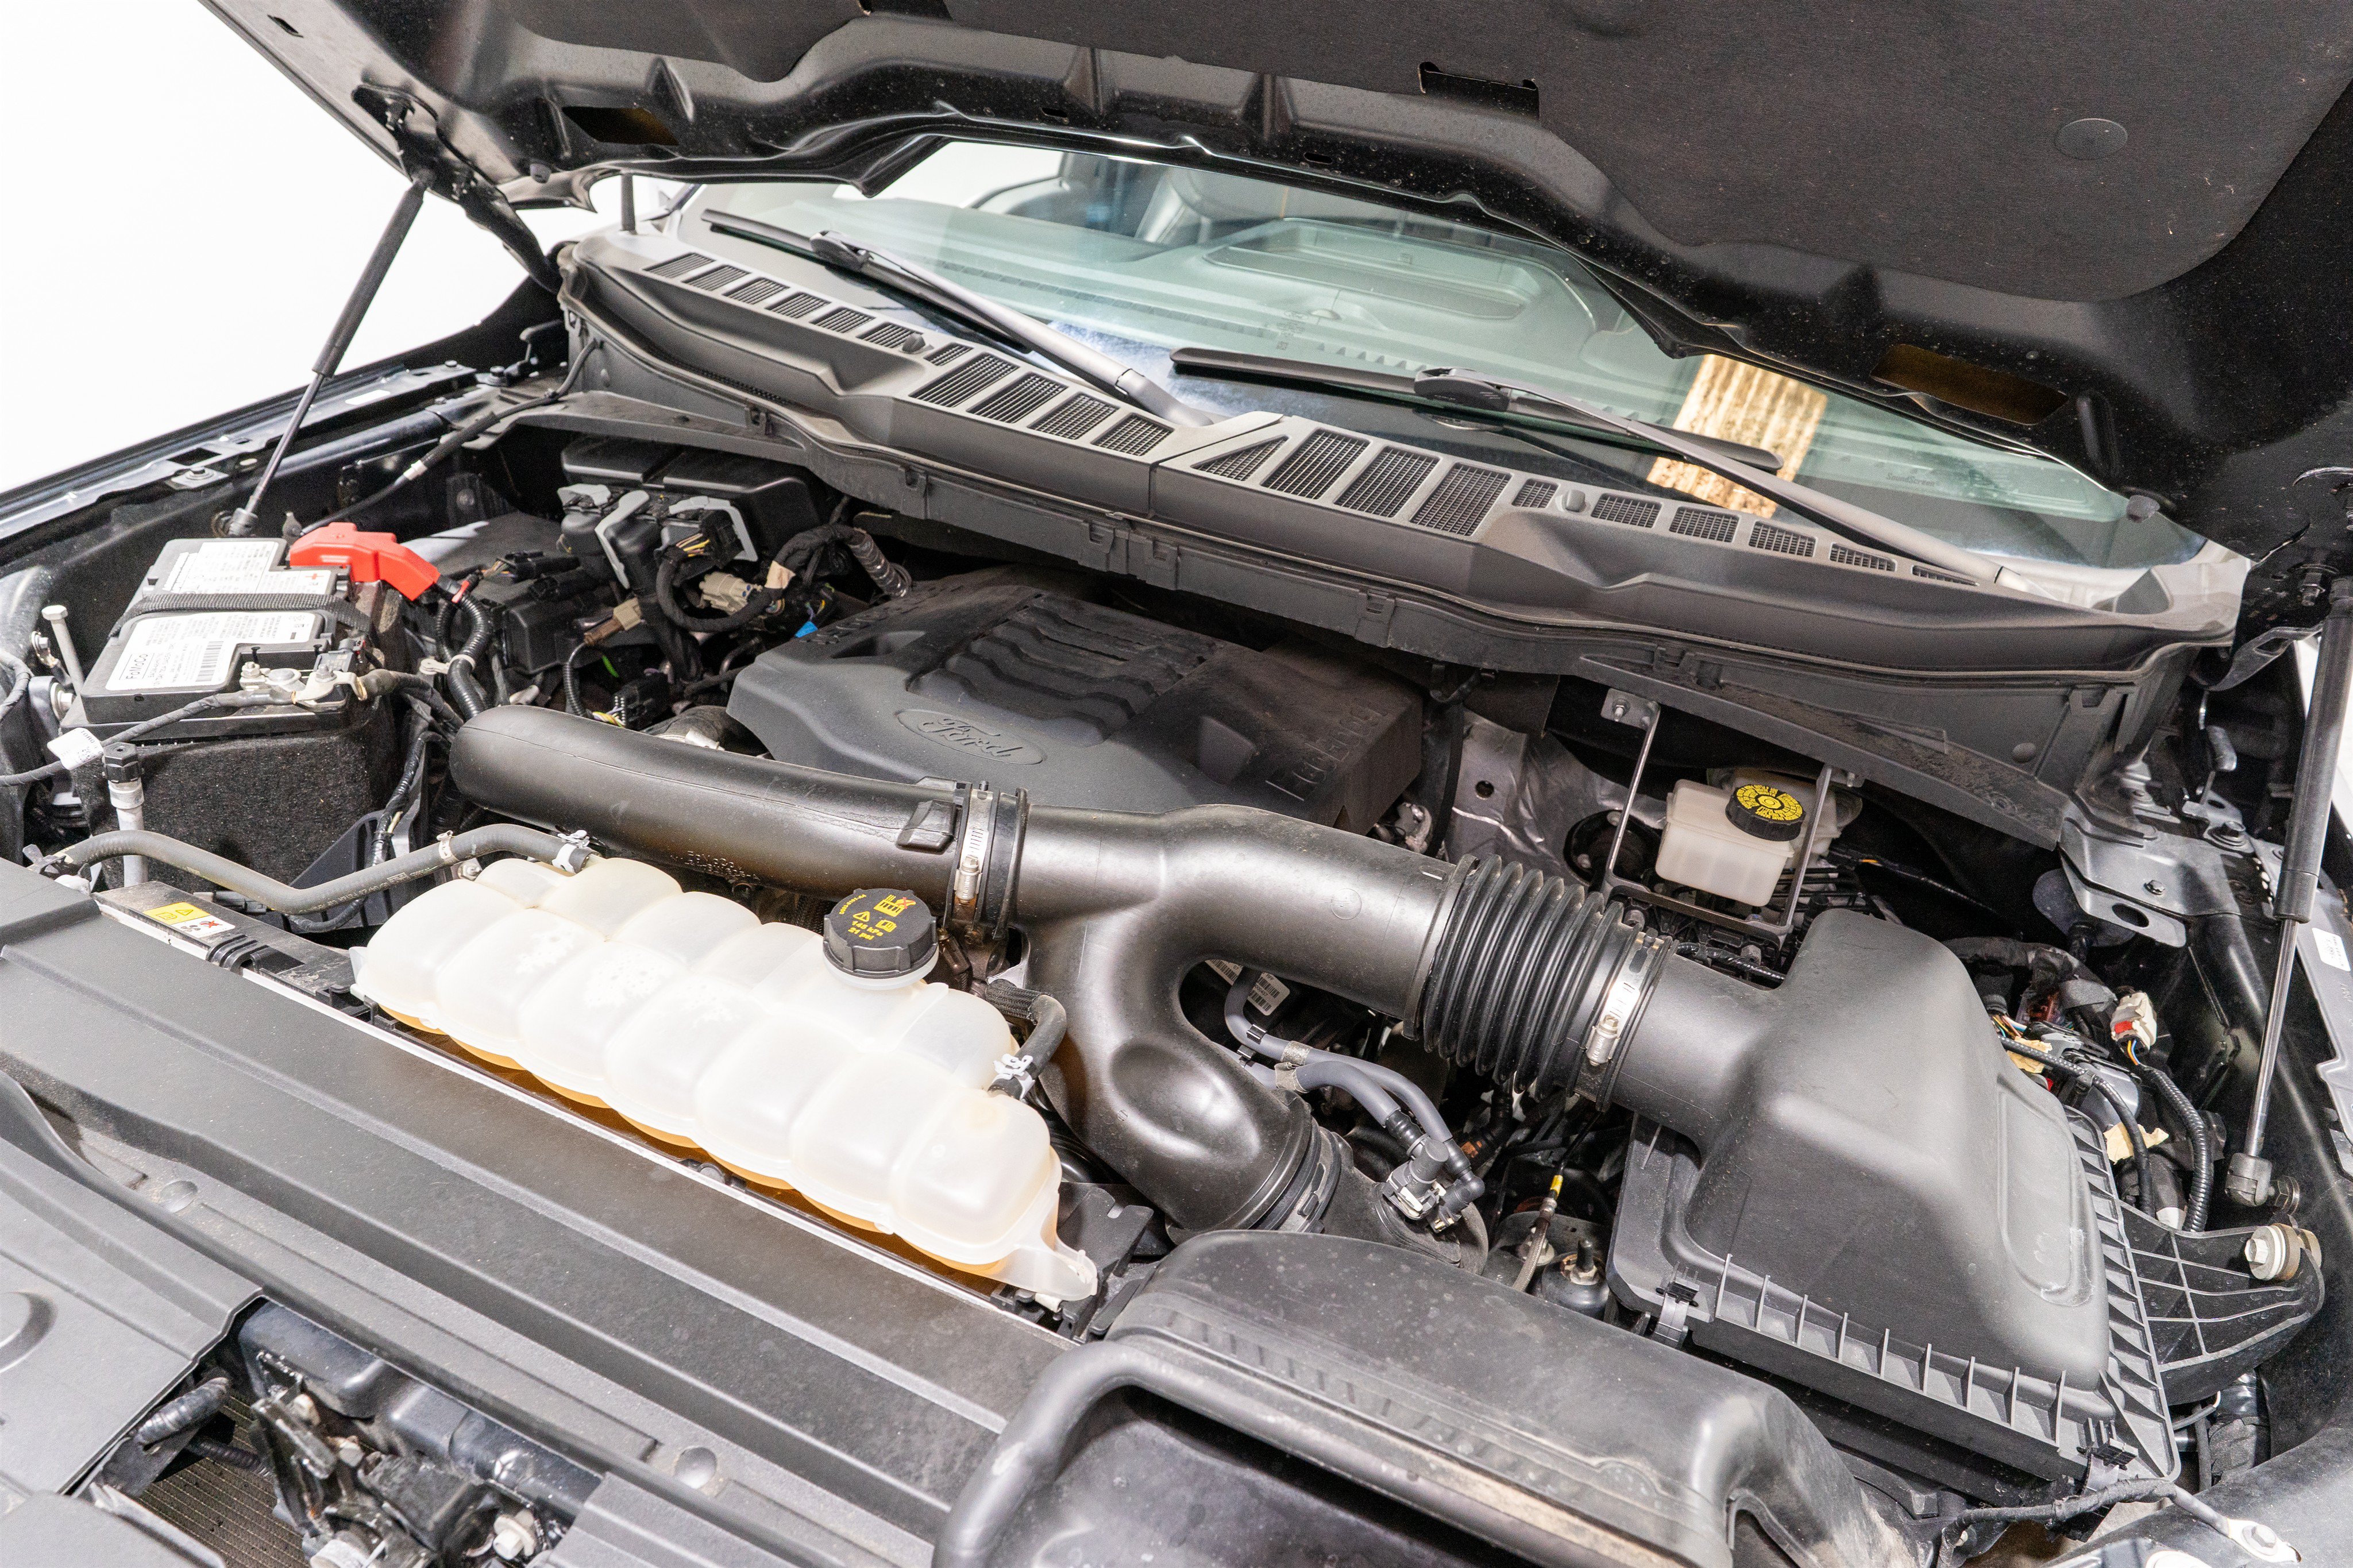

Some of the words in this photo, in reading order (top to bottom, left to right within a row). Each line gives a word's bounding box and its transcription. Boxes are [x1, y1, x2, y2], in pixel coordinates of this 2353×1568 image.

[125, 654, 148, 679] FoMoCo
[917, 718, 1023, 758] Ford
[851, 920, 868, 929] 145
[866, 926, 884, 937] kPa
[858, 932, 875, 940] psi
